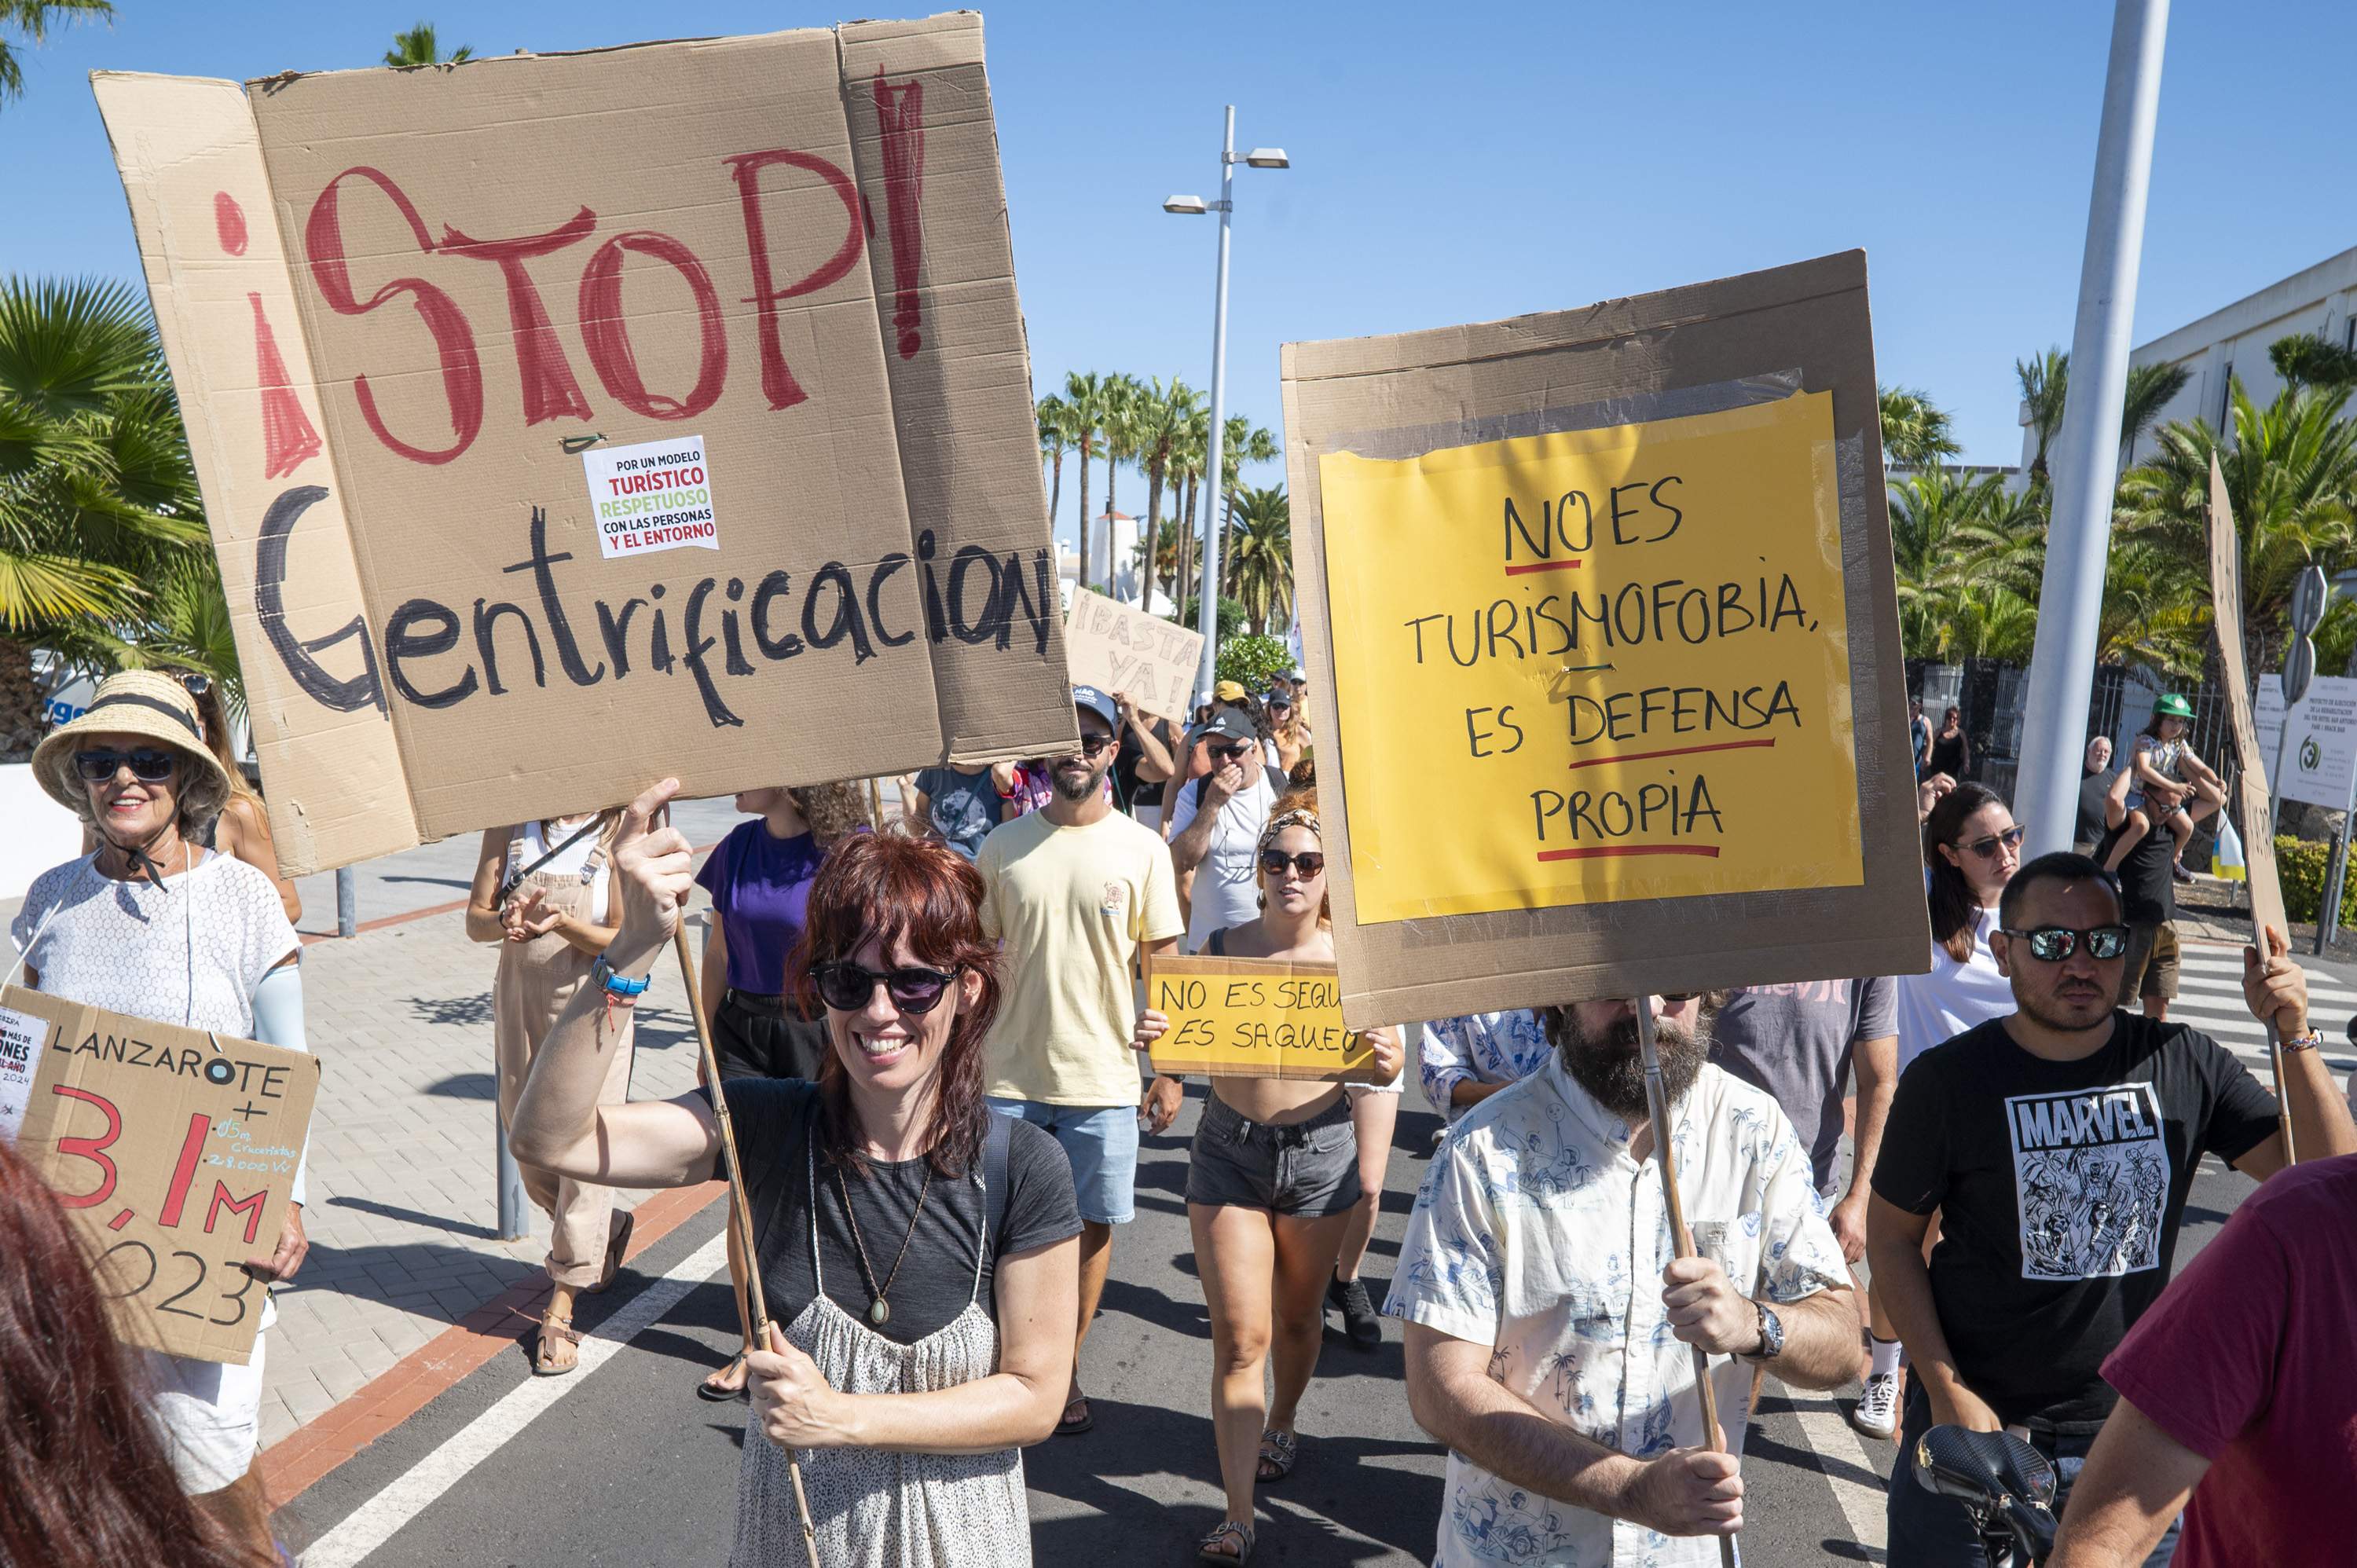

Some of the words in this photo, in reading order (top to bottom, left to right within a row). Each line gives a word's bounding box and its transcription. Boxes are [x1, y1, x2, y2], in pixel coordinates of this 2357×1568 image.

[617, 461, 639, 472] POR
[640, 456, 656, 468] UN
[658, 451, 701, 466] MODELO
[609, 467, 705, 496] TURÍSTICO
[599, 488, 709, 518] RESPETUOSO
[1504, 490, 1593, 561] NO
[1610, 476, 1683, 545] ES
[603, 520, 628, 534] CON
[629, 517, 651, 531] LAS
[652, 508, 712, 527] PERSONAS
[610, 535, 620, 551] Y
[623, 533, 642, 549] EL
[643, 522, 715, 546] ENTORNO
[1075, 593, 1198, 668] ¡BASTA
[1109, 650, 1183, 713] YA!
[1465, 705, 1524, 757] ES
[1566, 680, 1802, 746] DEFENSA
[1530, 769, 1724, 841] PROPIA
[1161, 980, 1207, 1011] NO
[1225, 983, 1266, 1007] ES
[1273, 981, 1342, 1010] SEQU
[22, 1035, 32, 1045] DE
[1174, 1019, 1215, 1046] ES
[1231, 1023, 1358, 1053] SAQUEO
[52, 1025, 291, 1098] LANZAROTE
[3, 1073, 30, 1086] 2024
[2018, 1091, 2155, 1149] MARVEL
[91, 1240, 254, 1326] 023
